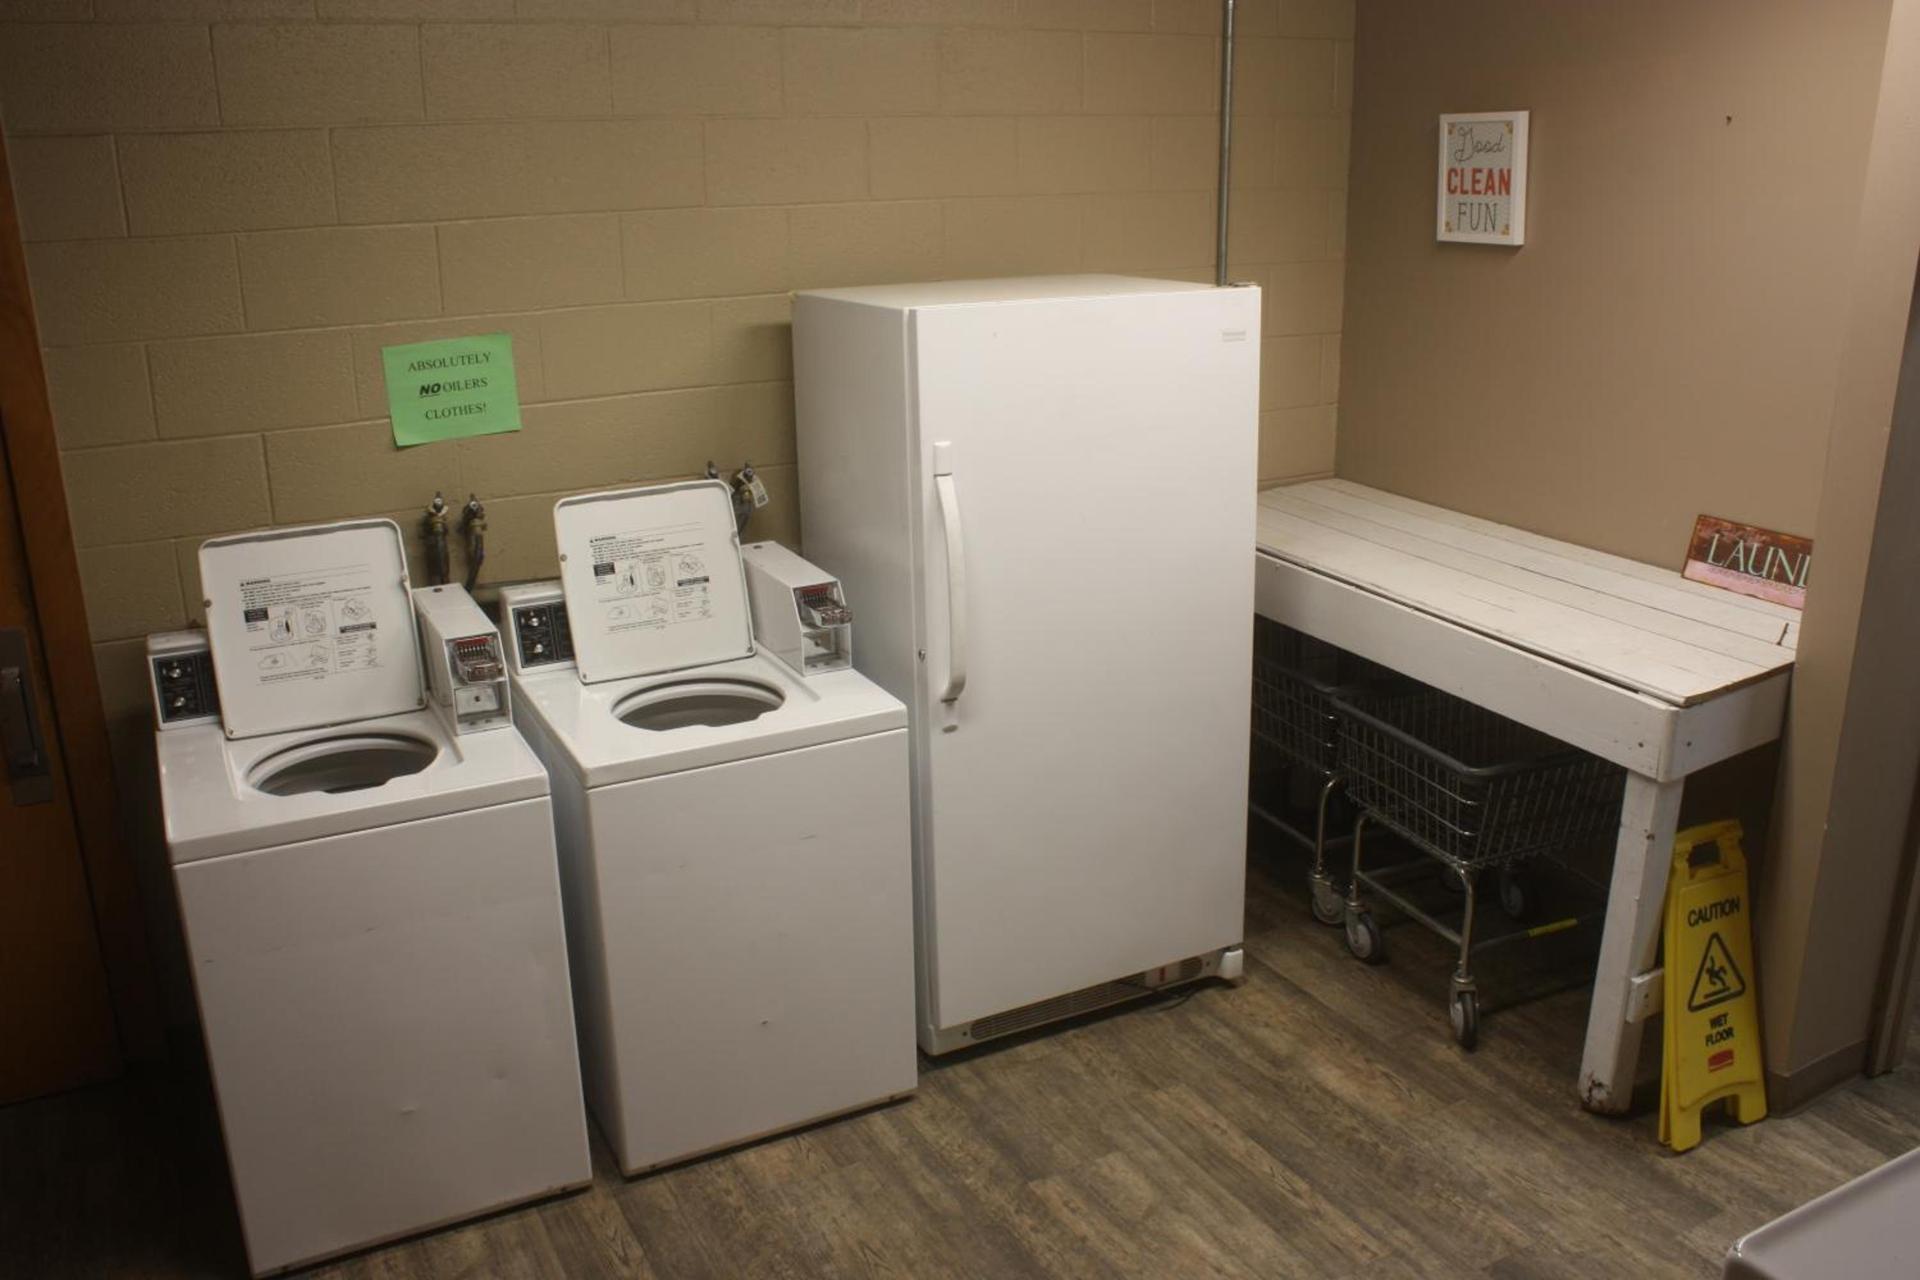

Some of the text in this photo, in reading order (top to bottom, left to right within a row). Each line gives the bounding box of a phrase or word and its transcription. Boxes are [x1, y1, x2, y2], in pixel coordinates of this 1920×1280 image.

[1447, 167, 1511, 196] CLEAN
[1457, 202, 1498, 232] FUN
[407, 352, 491, 372] ABSOLUTELY
[419, 377, 488, 396] NO OILERS
[424, 403, 487, 421] CLOTHES!
[1687, 896, 1740, 927] CAUTION
[1709, 1011, 1729, 1029] WET
[1705, 1026, 1735, 1047] FLOOR
